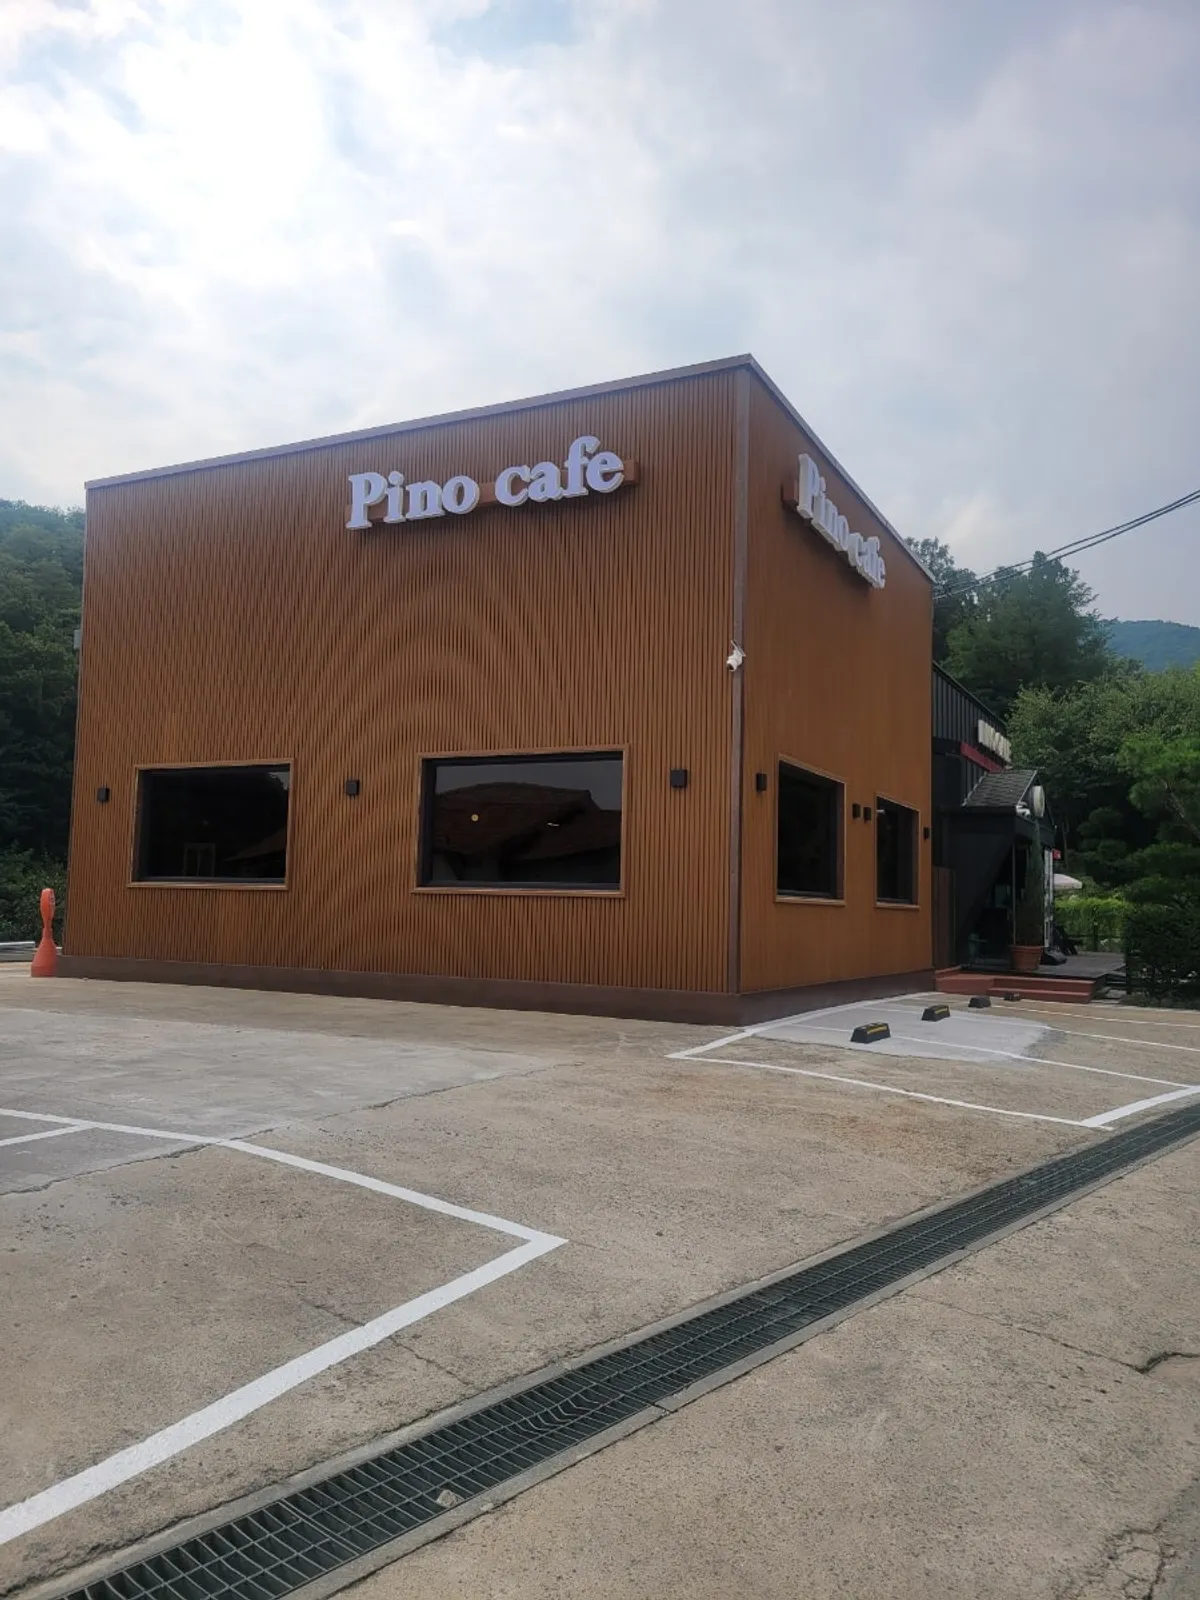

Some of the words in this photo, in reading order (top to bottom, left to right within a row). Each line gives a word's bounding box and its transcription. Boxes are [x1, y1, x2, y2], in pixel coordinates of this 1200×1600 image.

[346, 471, 480, 530] Pino
[495, 435, 625, 507] cafe
[796, 453, 849, 551] Pino
